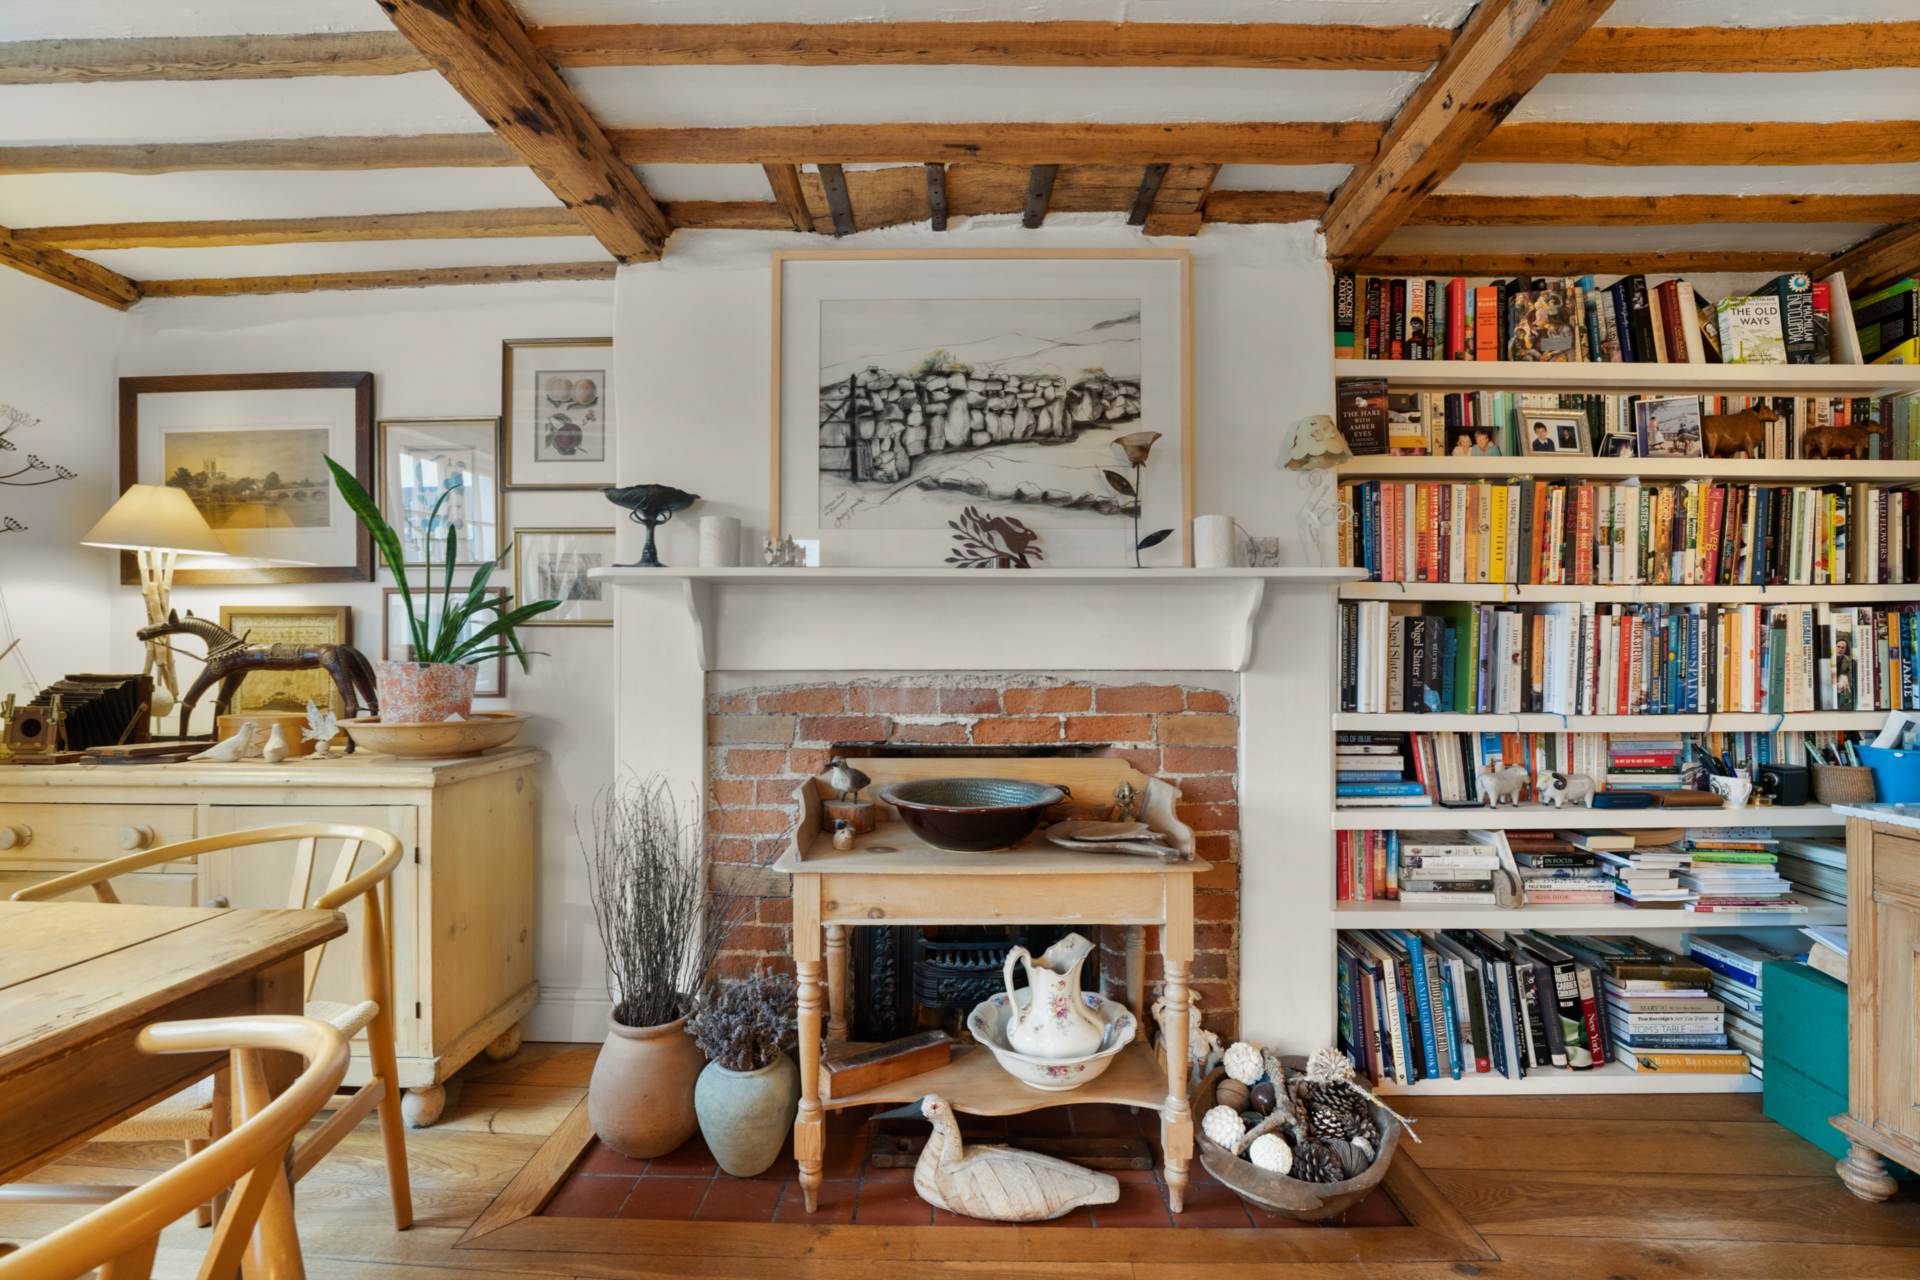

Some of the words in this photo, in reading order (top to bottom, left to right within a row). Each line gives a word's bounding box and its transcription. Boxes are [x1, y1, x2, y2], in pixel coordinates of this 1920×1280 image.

[1338, 280, 1346, 318] OXFORD
[1731, 308, 1752, 317] THE
[1755, 307, 1777, 316] OLD
[1740, 317, 1770, 326] WAYS
[1803, 305, 1815, 342] MACMILLAN
[1641, 490, 1649, 508] RICK
[1641, 508, 1649, 532] STEIN'S
[1706, 529, 1720, 552] Veg
[1391, 621, 1401, 648] Nigel
[1411, 620, 1425, 647] Nigel
[1632, 621, 1643, 640] RICK
[1802, 610, 1812, 646] JERUSALEM
[1902, 619, 1910, 647] SAVE
[1412, 649, 1424, 676] Slater
[1632, 640, 1643, 663] STEIN
[1391, 650, 1401, 682] Slater
[1585, 656, 1594, 690] OLIVE
[1903, 658, 1912, 698] JAMIE
[1688, 660, 1698, 700] SPAIN
[1554, 972, 1576, 982] ROBERT
[1430, 978, 1448, 1054] PHOTODISCOVERY
[1587, 1013, 1596, 1034] New
[1632, 1025, 1660, 1033] TOM'S
[1661, 1025, 1686, 1033] TABLE
[1373, 1030, 1381, 1054] Lofts
[1590, 1034, 1600, 1054] York
